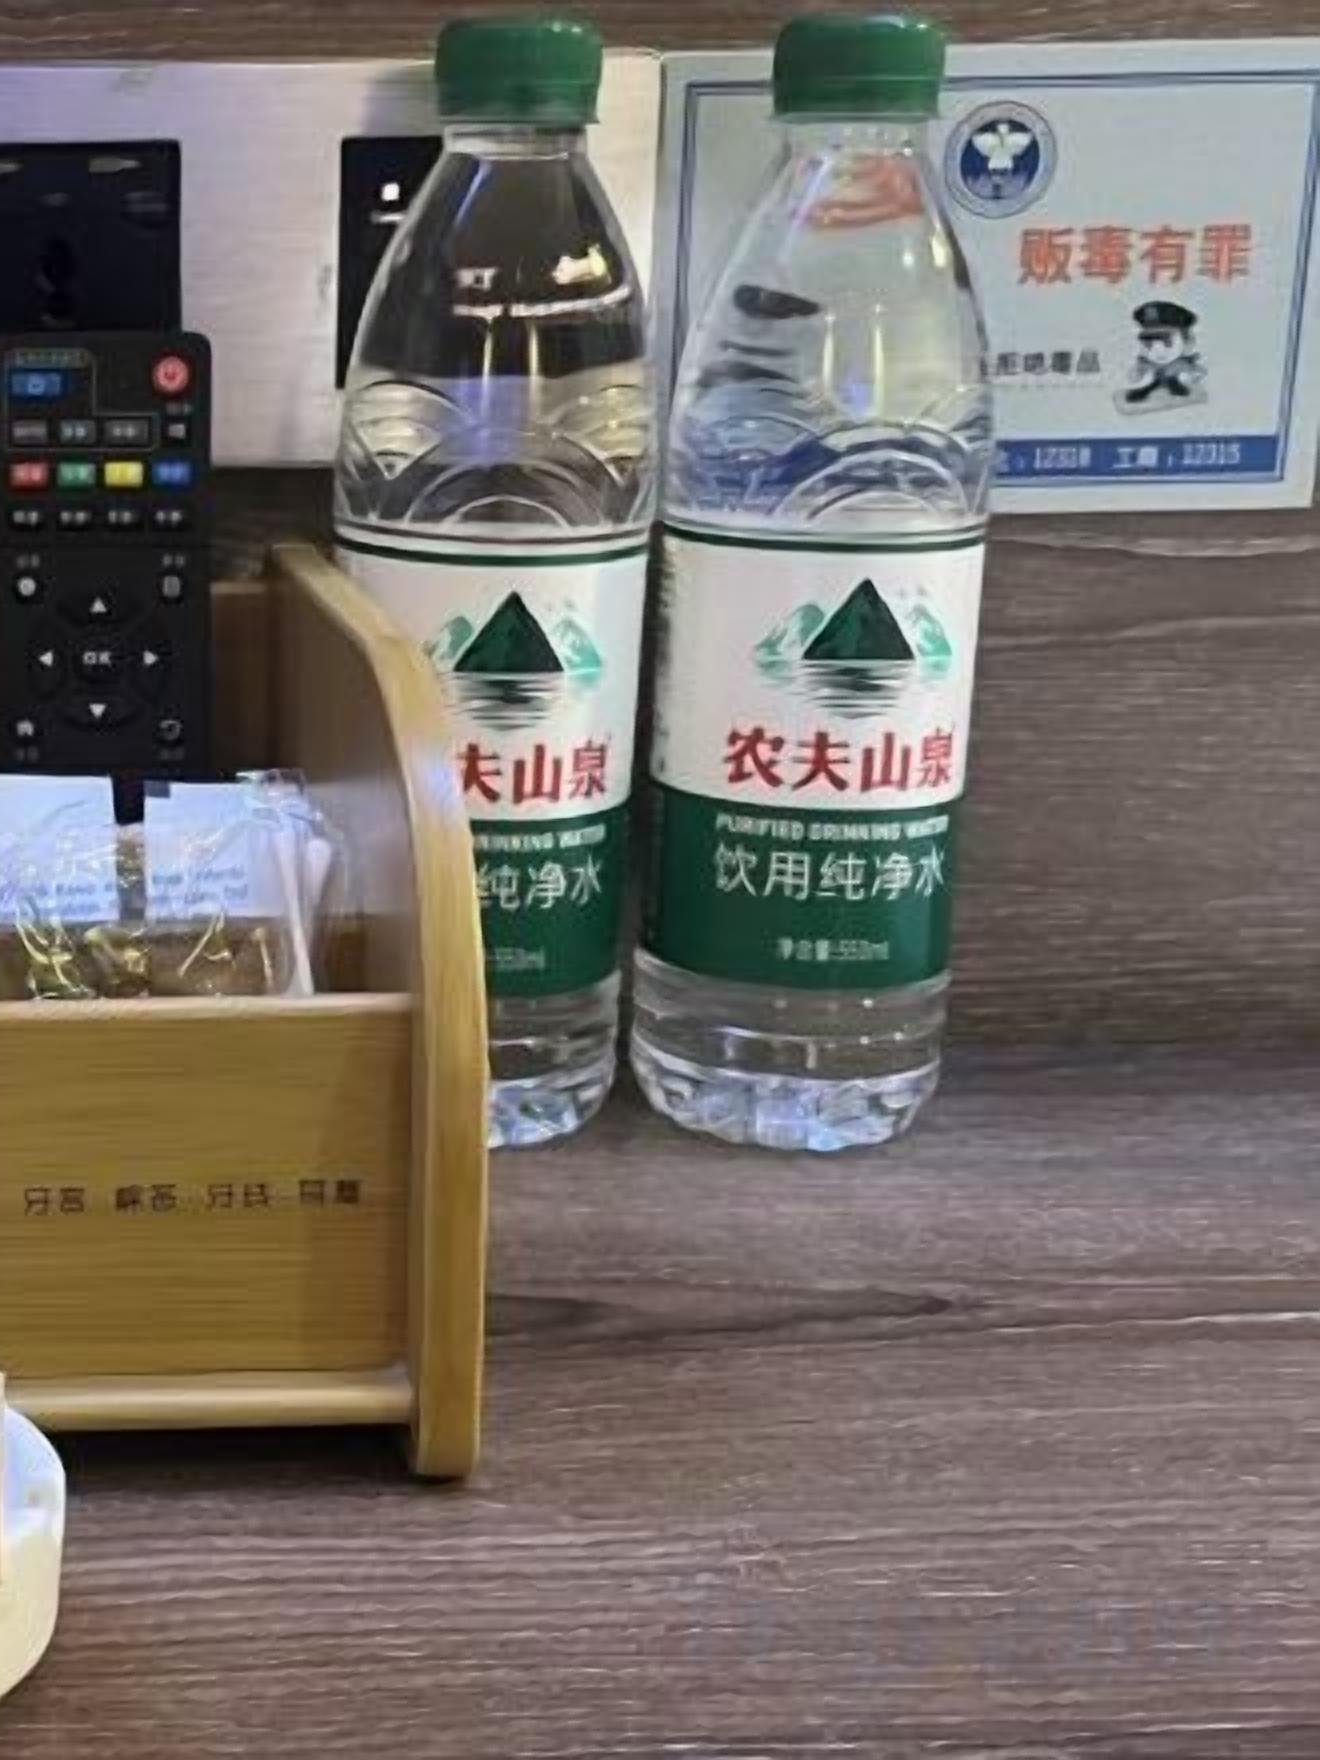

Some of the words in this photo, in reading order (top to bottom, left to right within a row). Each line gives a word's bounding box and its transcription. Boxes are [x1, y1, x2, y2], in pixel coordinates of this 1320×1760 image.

[1018, 224, 1252, 284] 贩毒有罪
[82, 651, 111, 666] OK
[724, 725, 954, 792] 农夫山泉
[715, 842, 946, 900] 饮用纯净水
